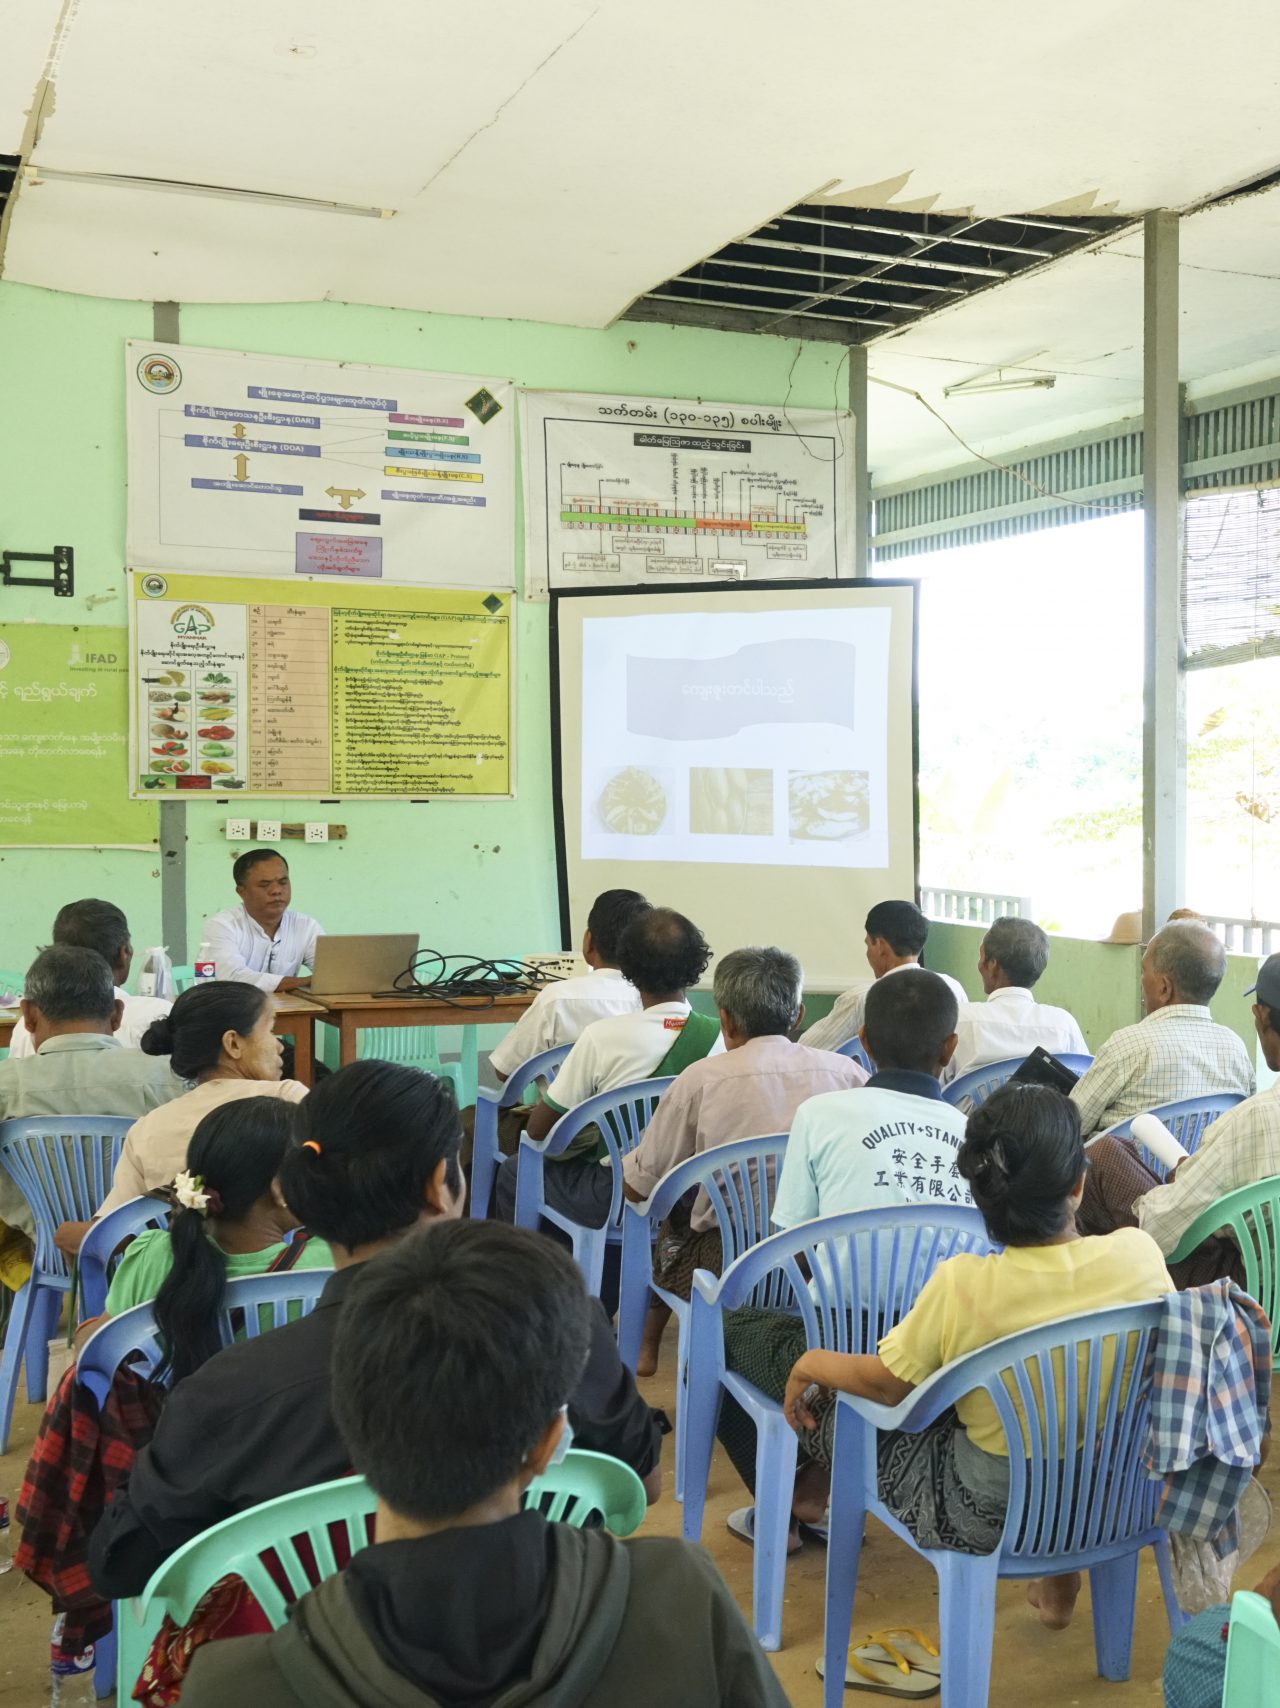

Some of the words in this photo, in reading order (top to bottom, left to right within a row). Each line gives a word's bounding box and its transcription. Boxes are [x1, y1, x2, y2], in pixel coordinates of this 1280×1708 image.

[598, 403, 657, 419] သက်တမ်း
[664, 406, 734, 429] (၁၃၀-၁၃၅)
[741, 414, 782, 432] စပါးမျိုး
[280, 443, 304, 454] (DOA)
[173, 614, 211, 635] GAP
[85, 653, 117, 664] IFAD
[14, 681, 97, 702] ရည်ရွယ်ချက်
[681, 678, 795, 704] ကျေးဇူးတင်ပါသည်
[862, 1122, 915, 1150] QUALITY
